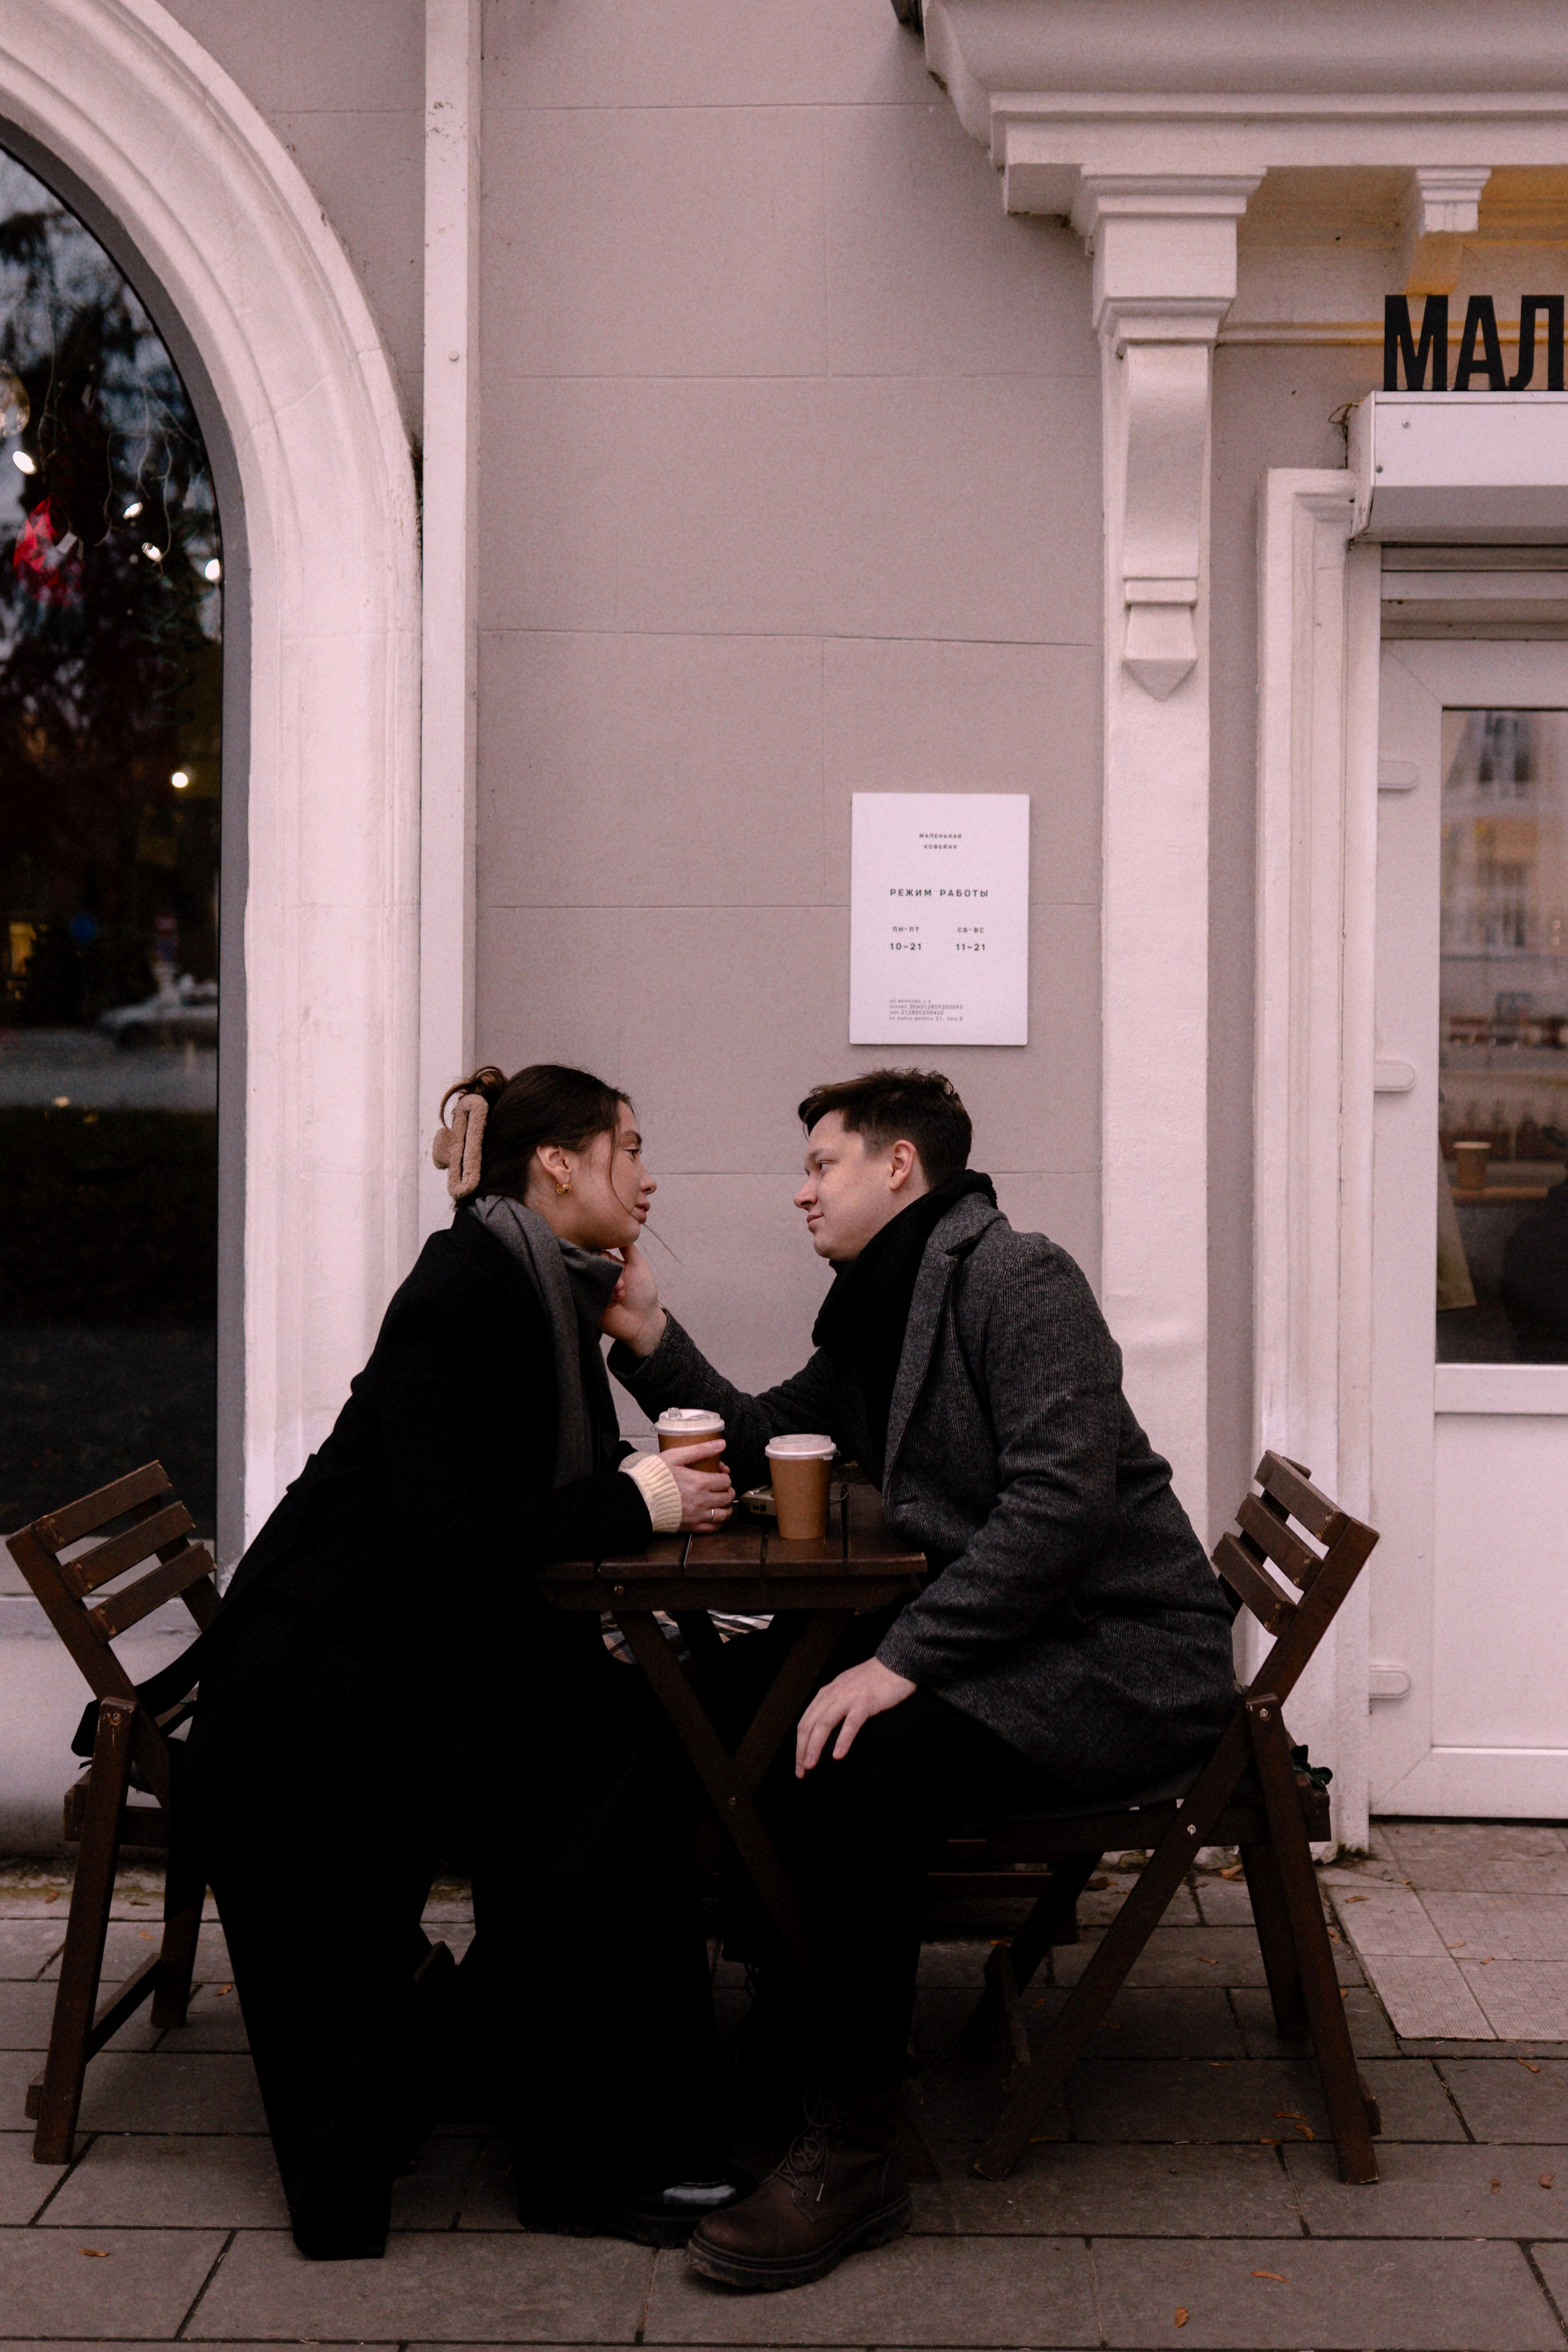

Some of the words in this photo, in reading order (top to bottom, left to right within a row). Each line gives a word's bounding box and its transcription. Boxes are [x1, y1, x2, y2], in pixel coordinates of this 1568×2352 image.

[1383, 295, 1564, 391] МАЛ
[940, 889, 989, 897] РАБОТЫ
[890, 942, 922, 951] 10-21
